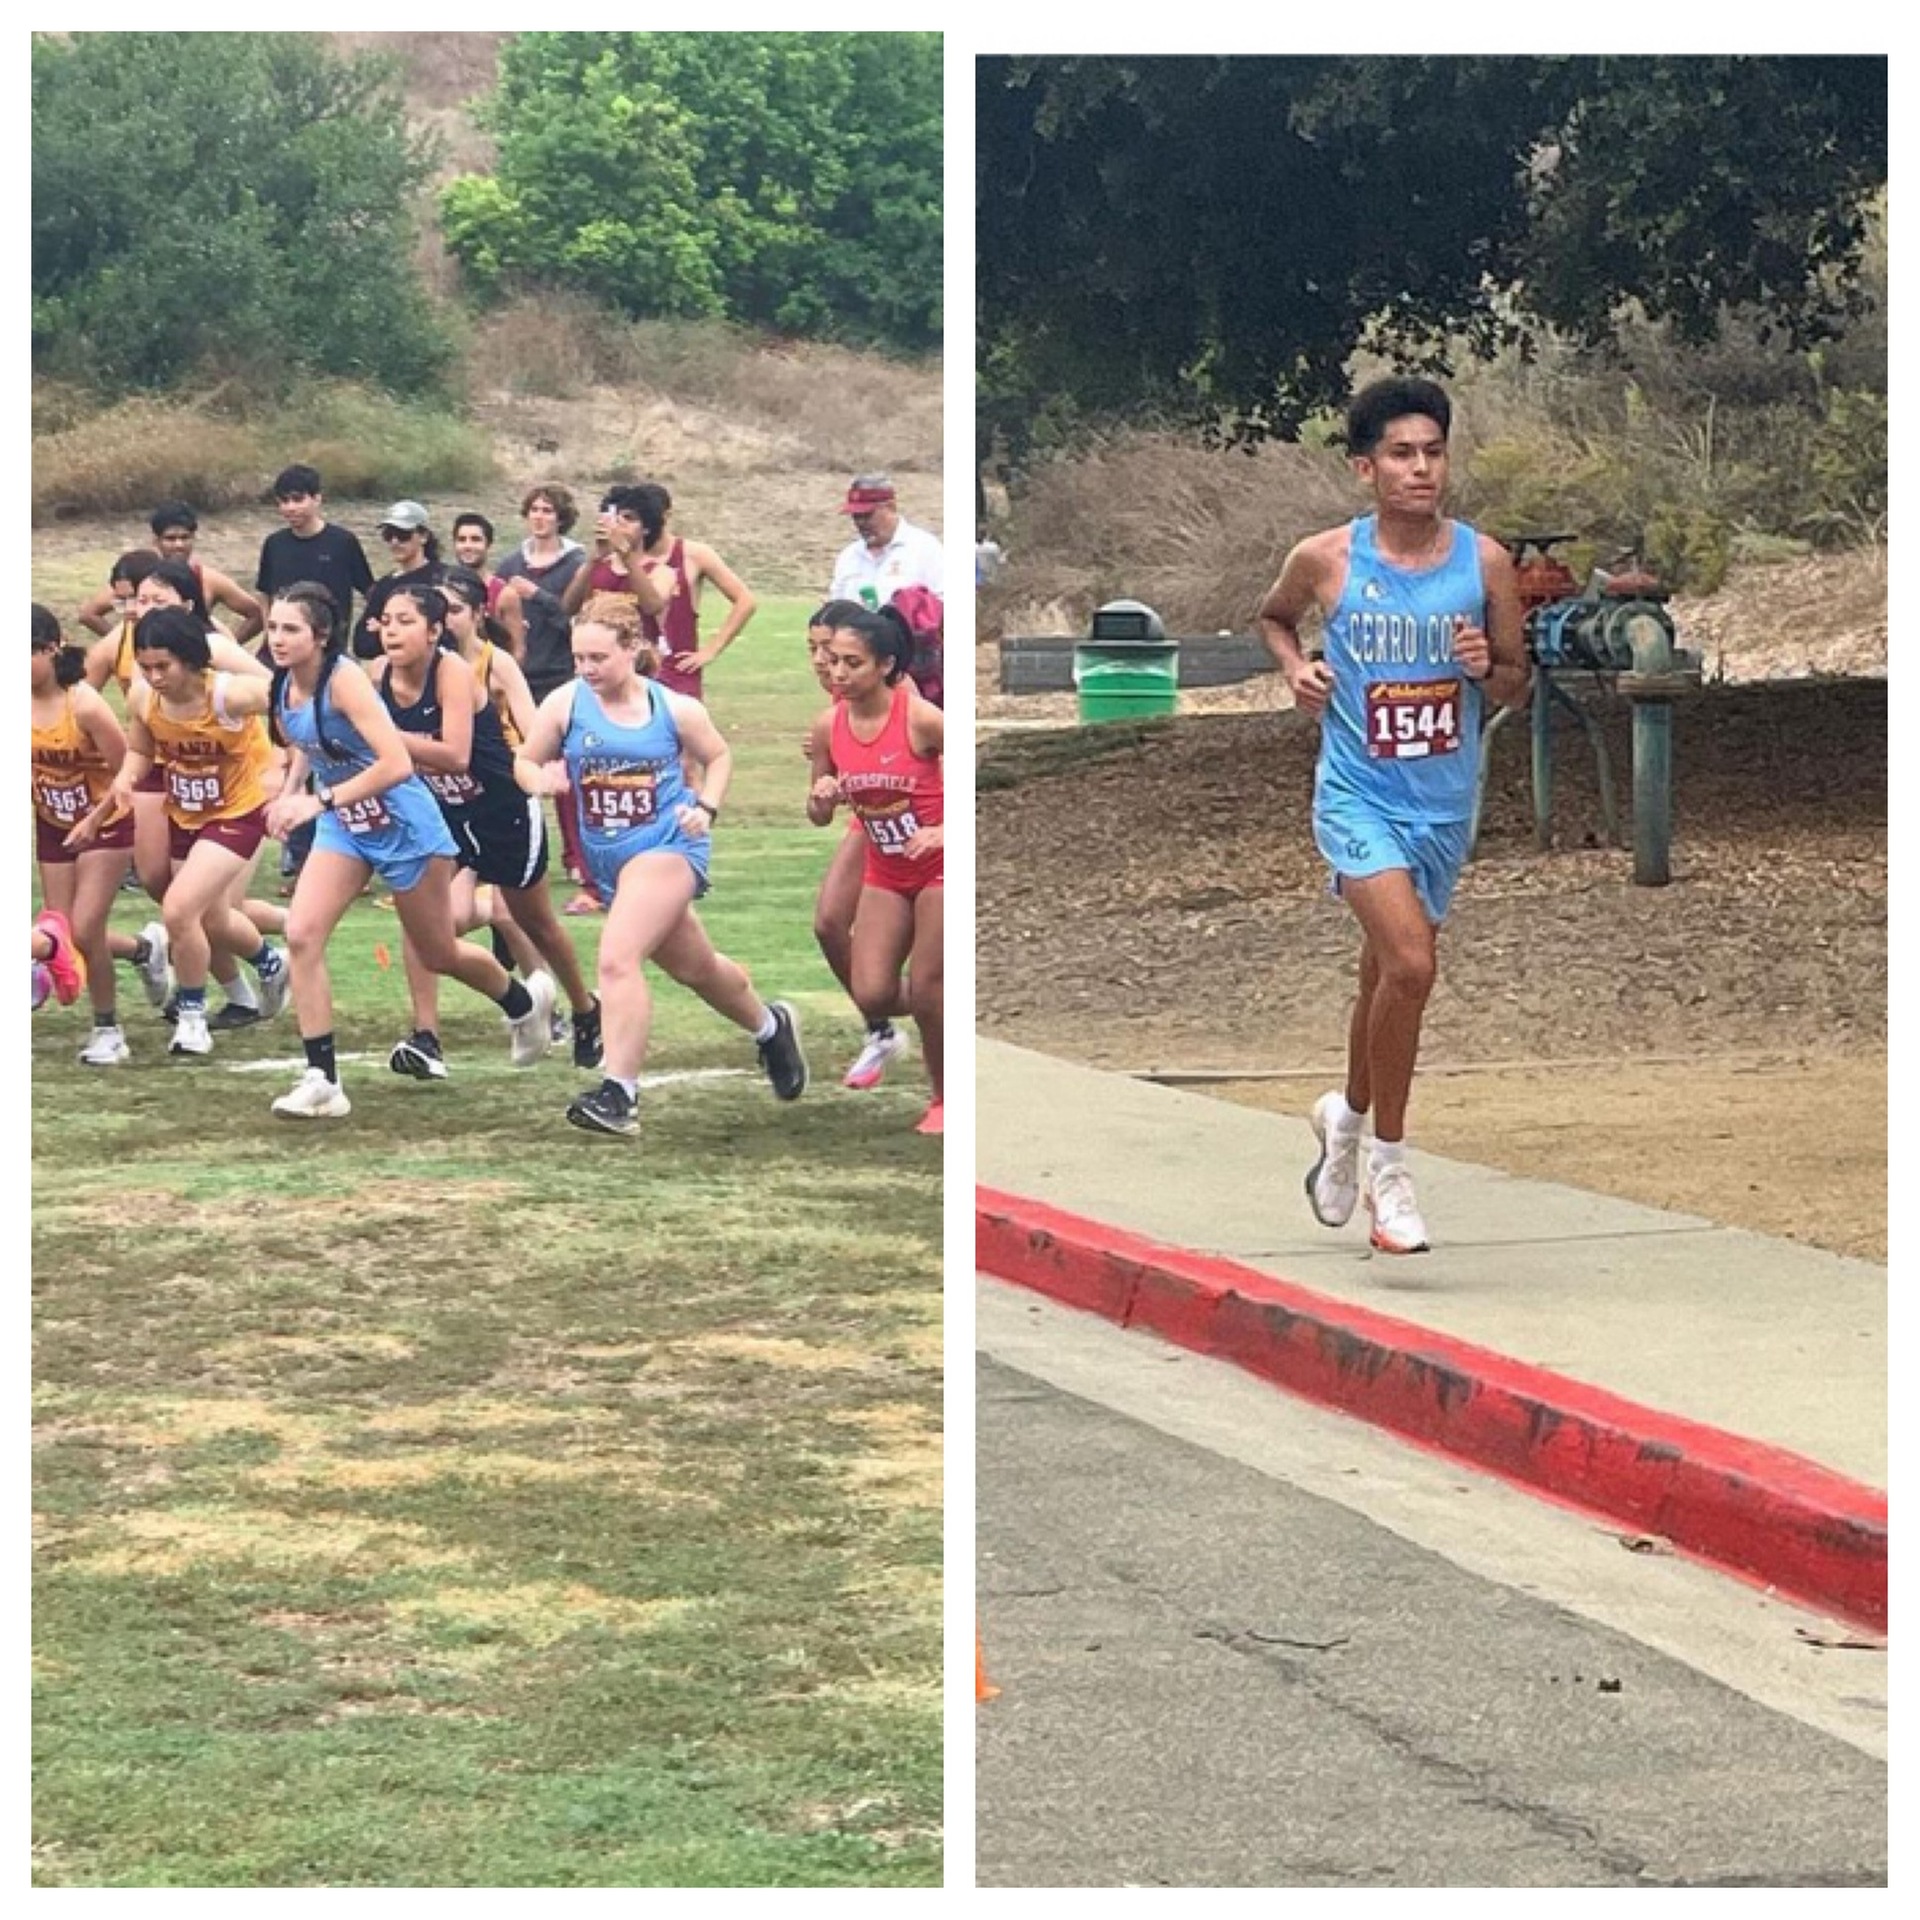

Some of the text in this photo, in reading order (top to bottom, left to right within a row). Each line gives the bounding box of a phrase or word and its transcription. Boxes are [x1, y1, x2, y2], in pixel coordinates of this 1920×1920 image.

[1350, 613, 1472, 664] CERRO CO
[1375, 702, 1455, 741] 1544
[41, 784, 88, 812] 1563
[170, 774, 219, 801] 1569
[589, 788, 652, 817] 1543
